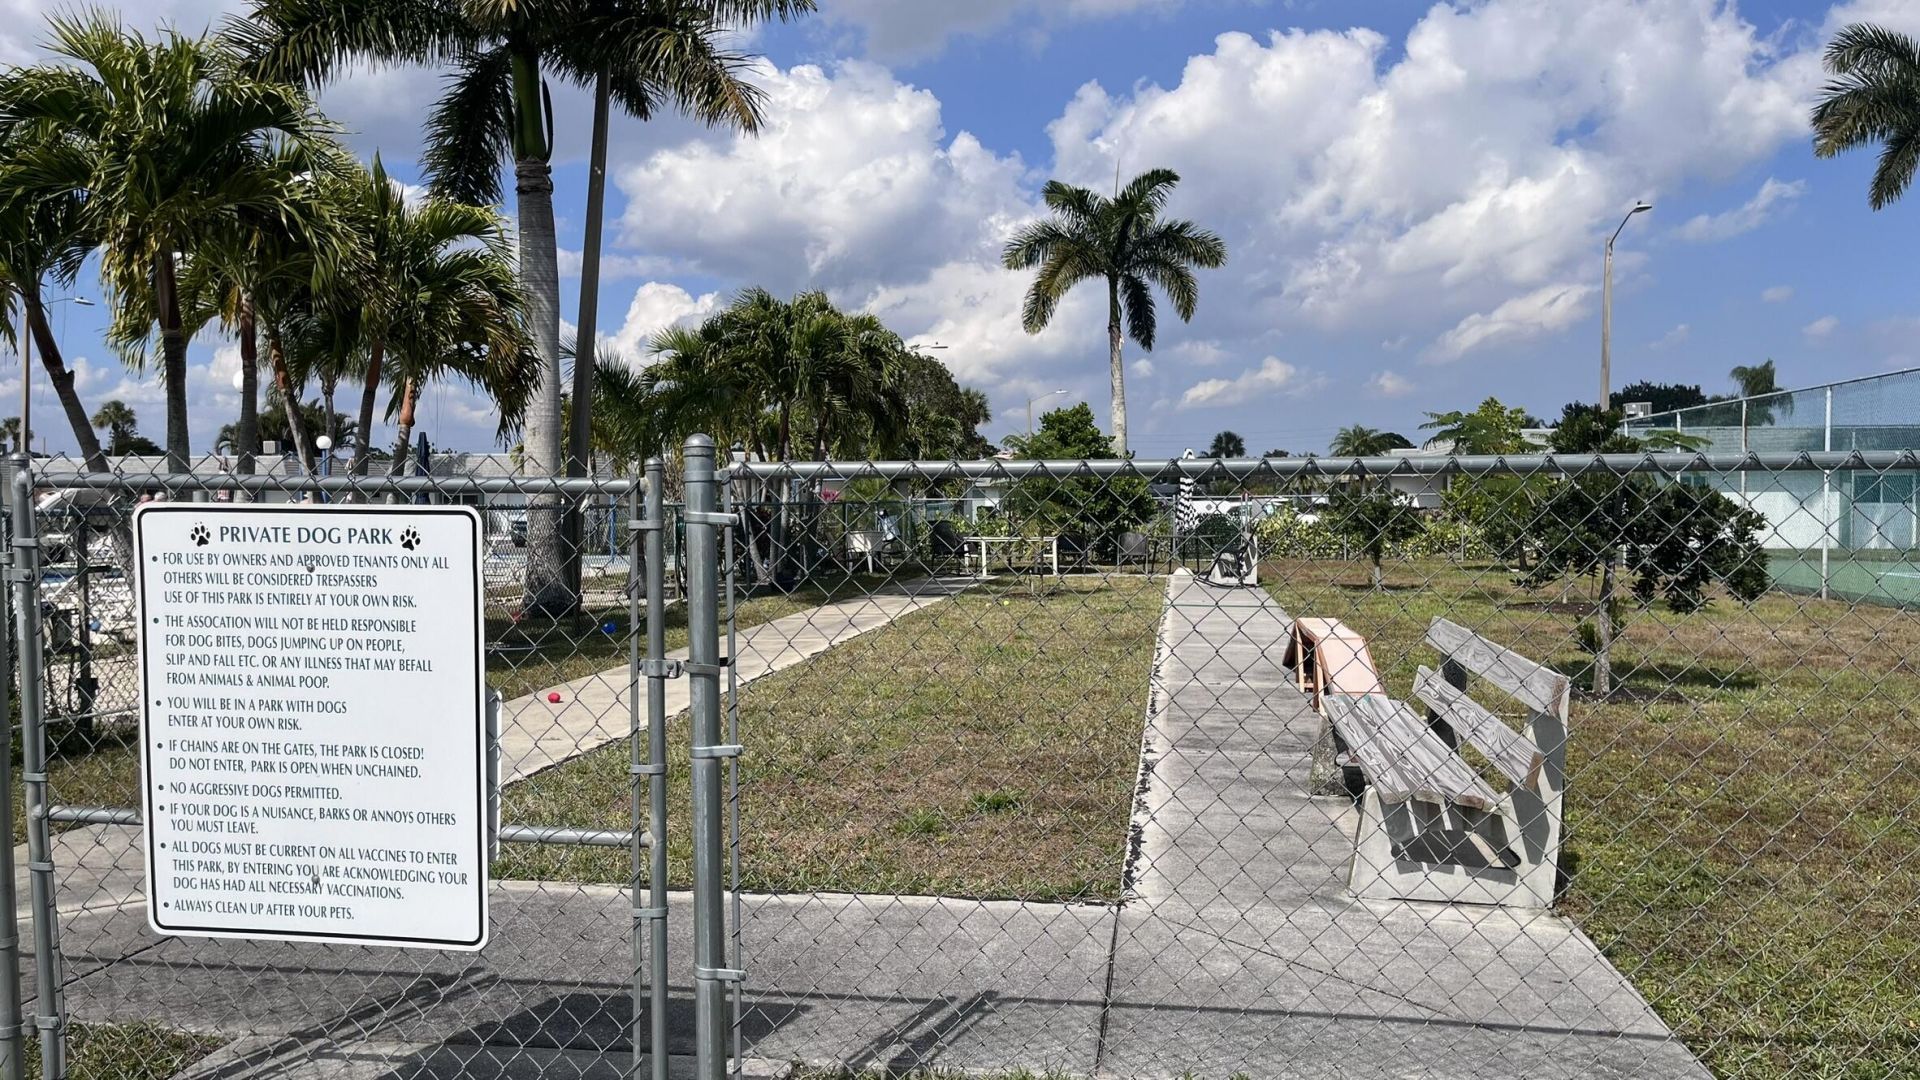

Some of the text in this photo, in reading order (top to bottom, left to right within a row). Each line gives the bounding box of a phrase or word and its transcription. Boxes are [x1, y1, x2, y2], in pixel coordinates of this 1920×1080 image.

[219, 526, 392, 544] PRIVATE DOG PARK
[163, 552, 449, 568] FOR USE BY OWNERS AND APPROVED TENANTS ONLY ALL
[163, 571, 377, 587] OTHERS WILL BE CONSIDERED TRESPASSERS
[164, 590, 416, 607] USE OF THIS PARK IS ENTIRELY AT YOUR OWN RISK.
[164, 615, 416, 632] THE ASSOCATION WILL NOT BE HELD RESPONSIBLE
[165, 634, 405, 652] FOR DOG BITES, DOGS JUMPING UP ON PEOPLE,
[165, 653, 432, 671] SLIP AND FALL ETC. OR ANY ILLNESS THAT MAY BEFALL
[166, 672, 329, 688] FROM ANIMALS & ANIMAL POOP.
[167, 696, 347, 713] YOU WILL BE IN A PARK WITH DOGS
[168, 714, 301, 730] ENTER AT YOUR OWN RISK.
[169, 739, 424, 759] IF CHAINS ARE ON THE GATES, THE PARK IS CLOSED!
[169, 757, 421, 777] DO NOT ENTER, PARK IS OPEN WHEN UNCHAINED.
[170, 781, 342, 799] NO AGGRESSIVE DOGS PERMITTED.
[170, 802, 456, 824] IF YOUR DOG IS A NUISANCE, BARKS OR ANNOYS OTHERS
[171, 819, 258, 833] YOU MUST LEAVE.
[172, 840, 457, 864] ALL DOGS MUST BE CURRENT ON ALL VACCINES TO ENTER
[172, 859, 467, 884] THIS PARK, BY ENTERING YOU ARE ACKNOWLEDGING YOUR
[173, 876, 404, 898] DOG HAS HAD ALL NECESSARY VACCINATIONS.
[174, 899, 354, 919] ALWAYS CLEAN UP AFTER YOUR PETS.
